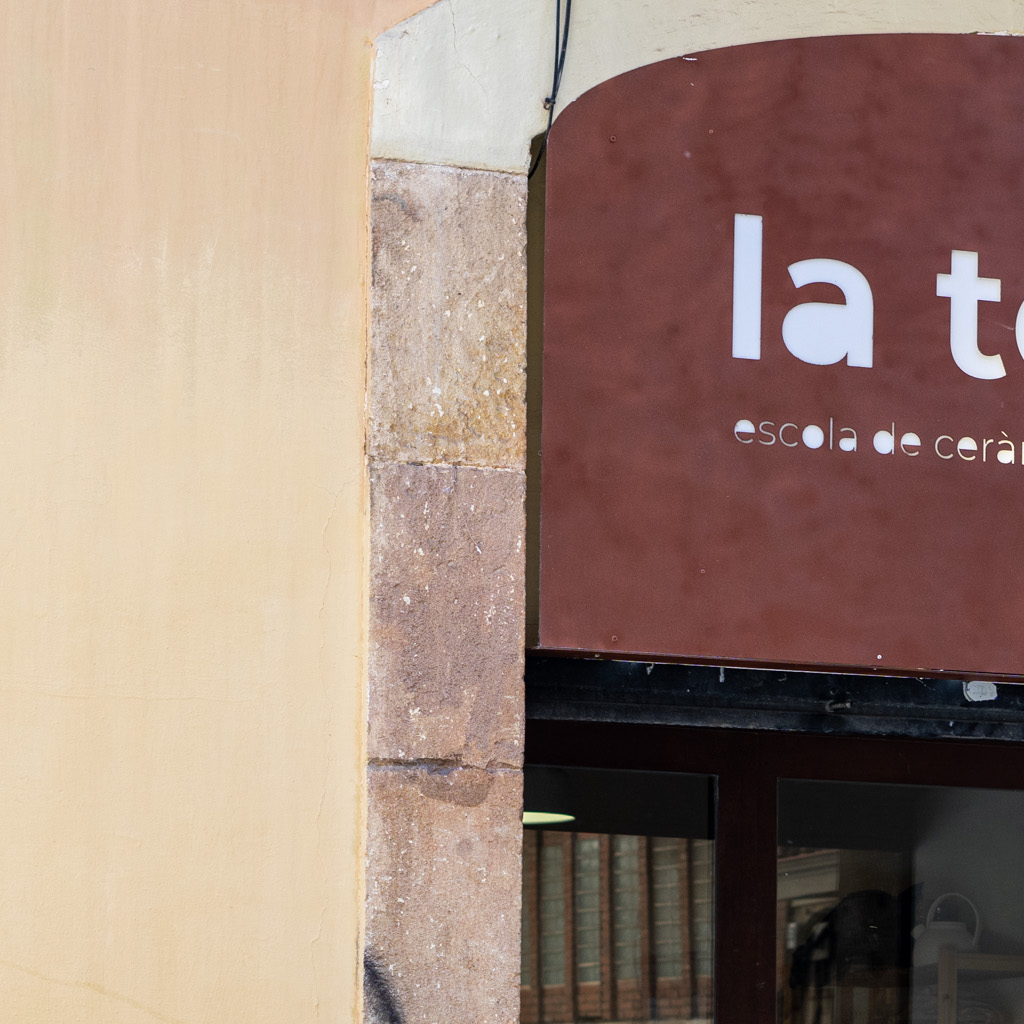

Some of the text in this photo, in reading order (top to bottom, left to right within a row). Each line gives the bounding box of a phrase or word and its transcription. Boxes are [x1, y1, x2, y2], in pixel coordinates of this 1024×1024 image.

[731, 213, 874, 369] la
[733, 417, 858, 452] escola
[872, 421, 922, 457] de
